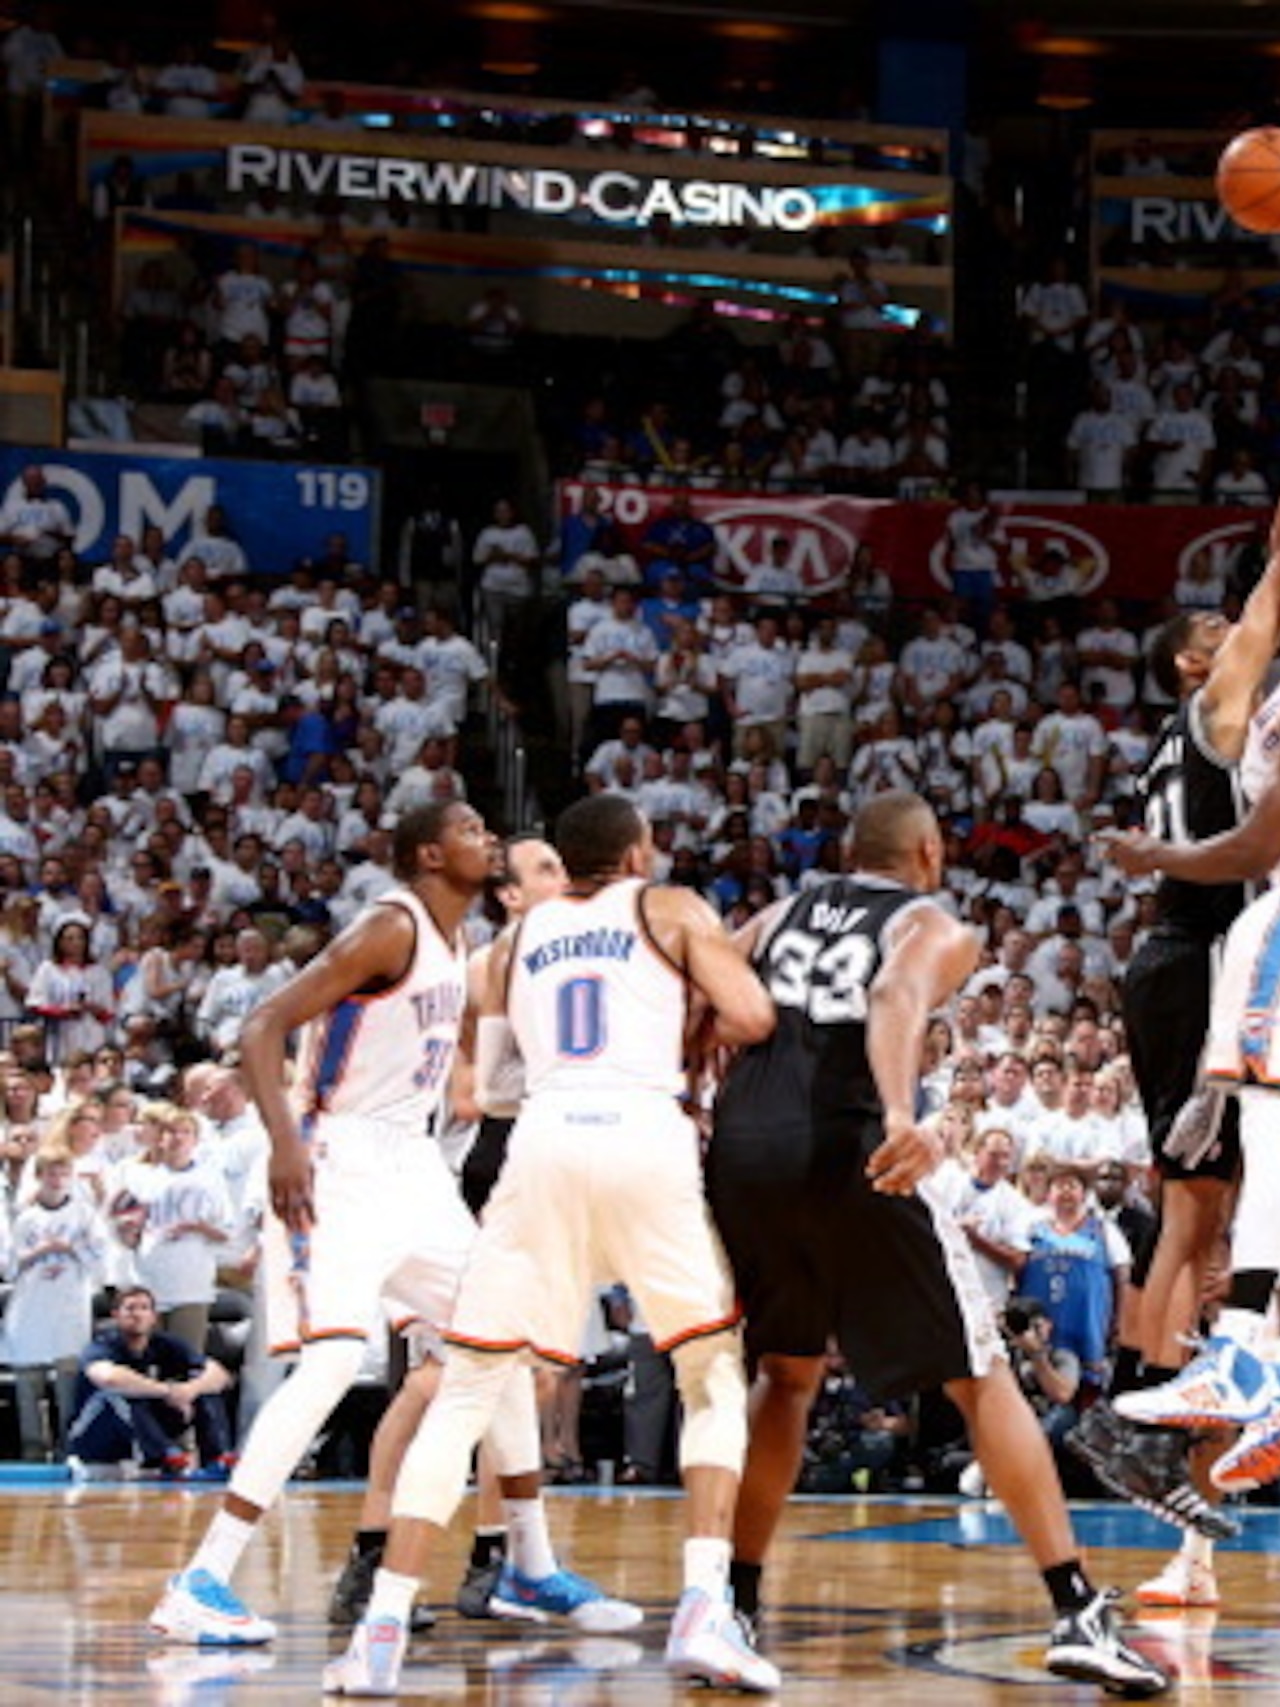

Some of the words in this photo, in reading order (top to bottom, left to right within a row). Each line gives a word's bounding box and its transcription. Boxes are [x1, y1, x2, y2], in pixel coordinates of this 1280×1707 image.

[225, 143, 577, 214] RIVERWIND
[587, 171, 816, 232] CASINO
[296, 471, 370, 511] 119
[555, 970, 608, 1062] 0
[769, 929, 876, 1024] 33
